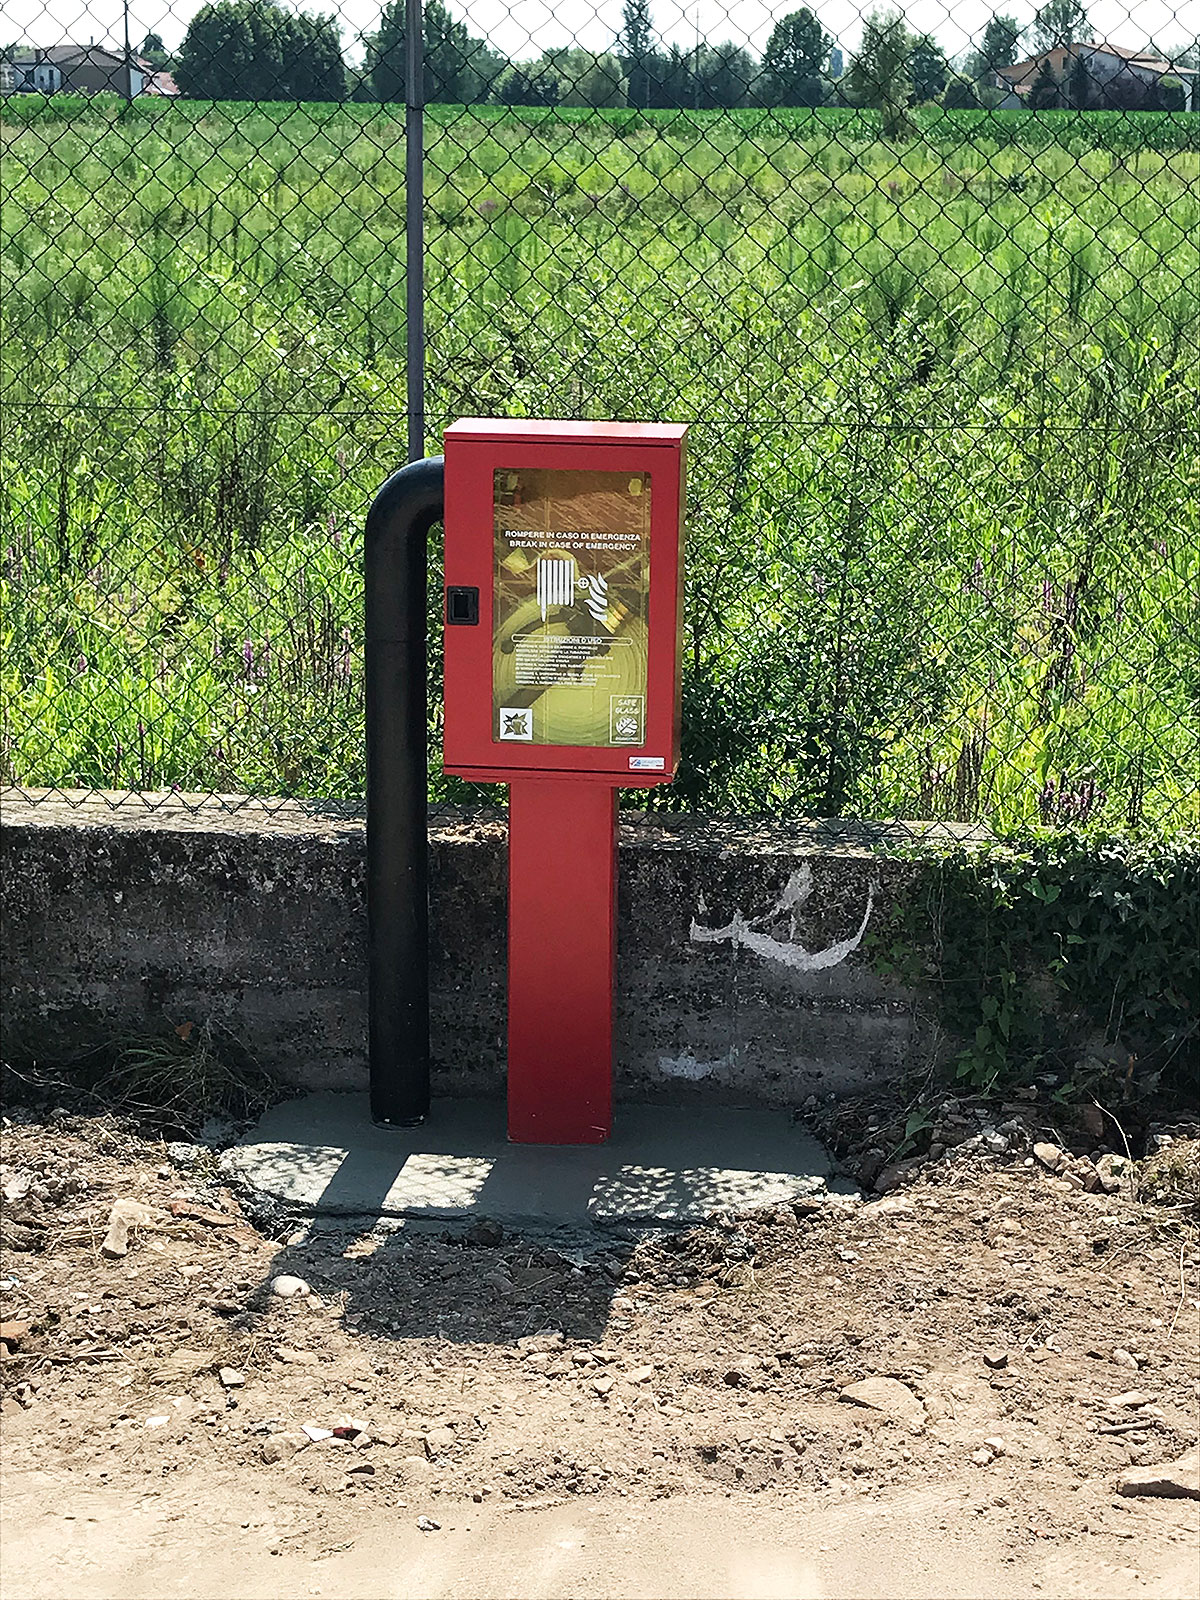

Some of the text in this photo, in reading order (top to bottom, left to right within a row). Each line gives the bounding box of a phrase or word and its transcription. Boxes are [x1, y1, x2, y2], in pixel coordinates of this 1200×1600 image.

[505, 530, 641, 541] ROMPERE IN CASO DI EMERGENZA
[509, 540, 538, 548] BREAK
[548, 541, 571, 549] CASE
[585, 542, 637, 551] EMERGENCY
